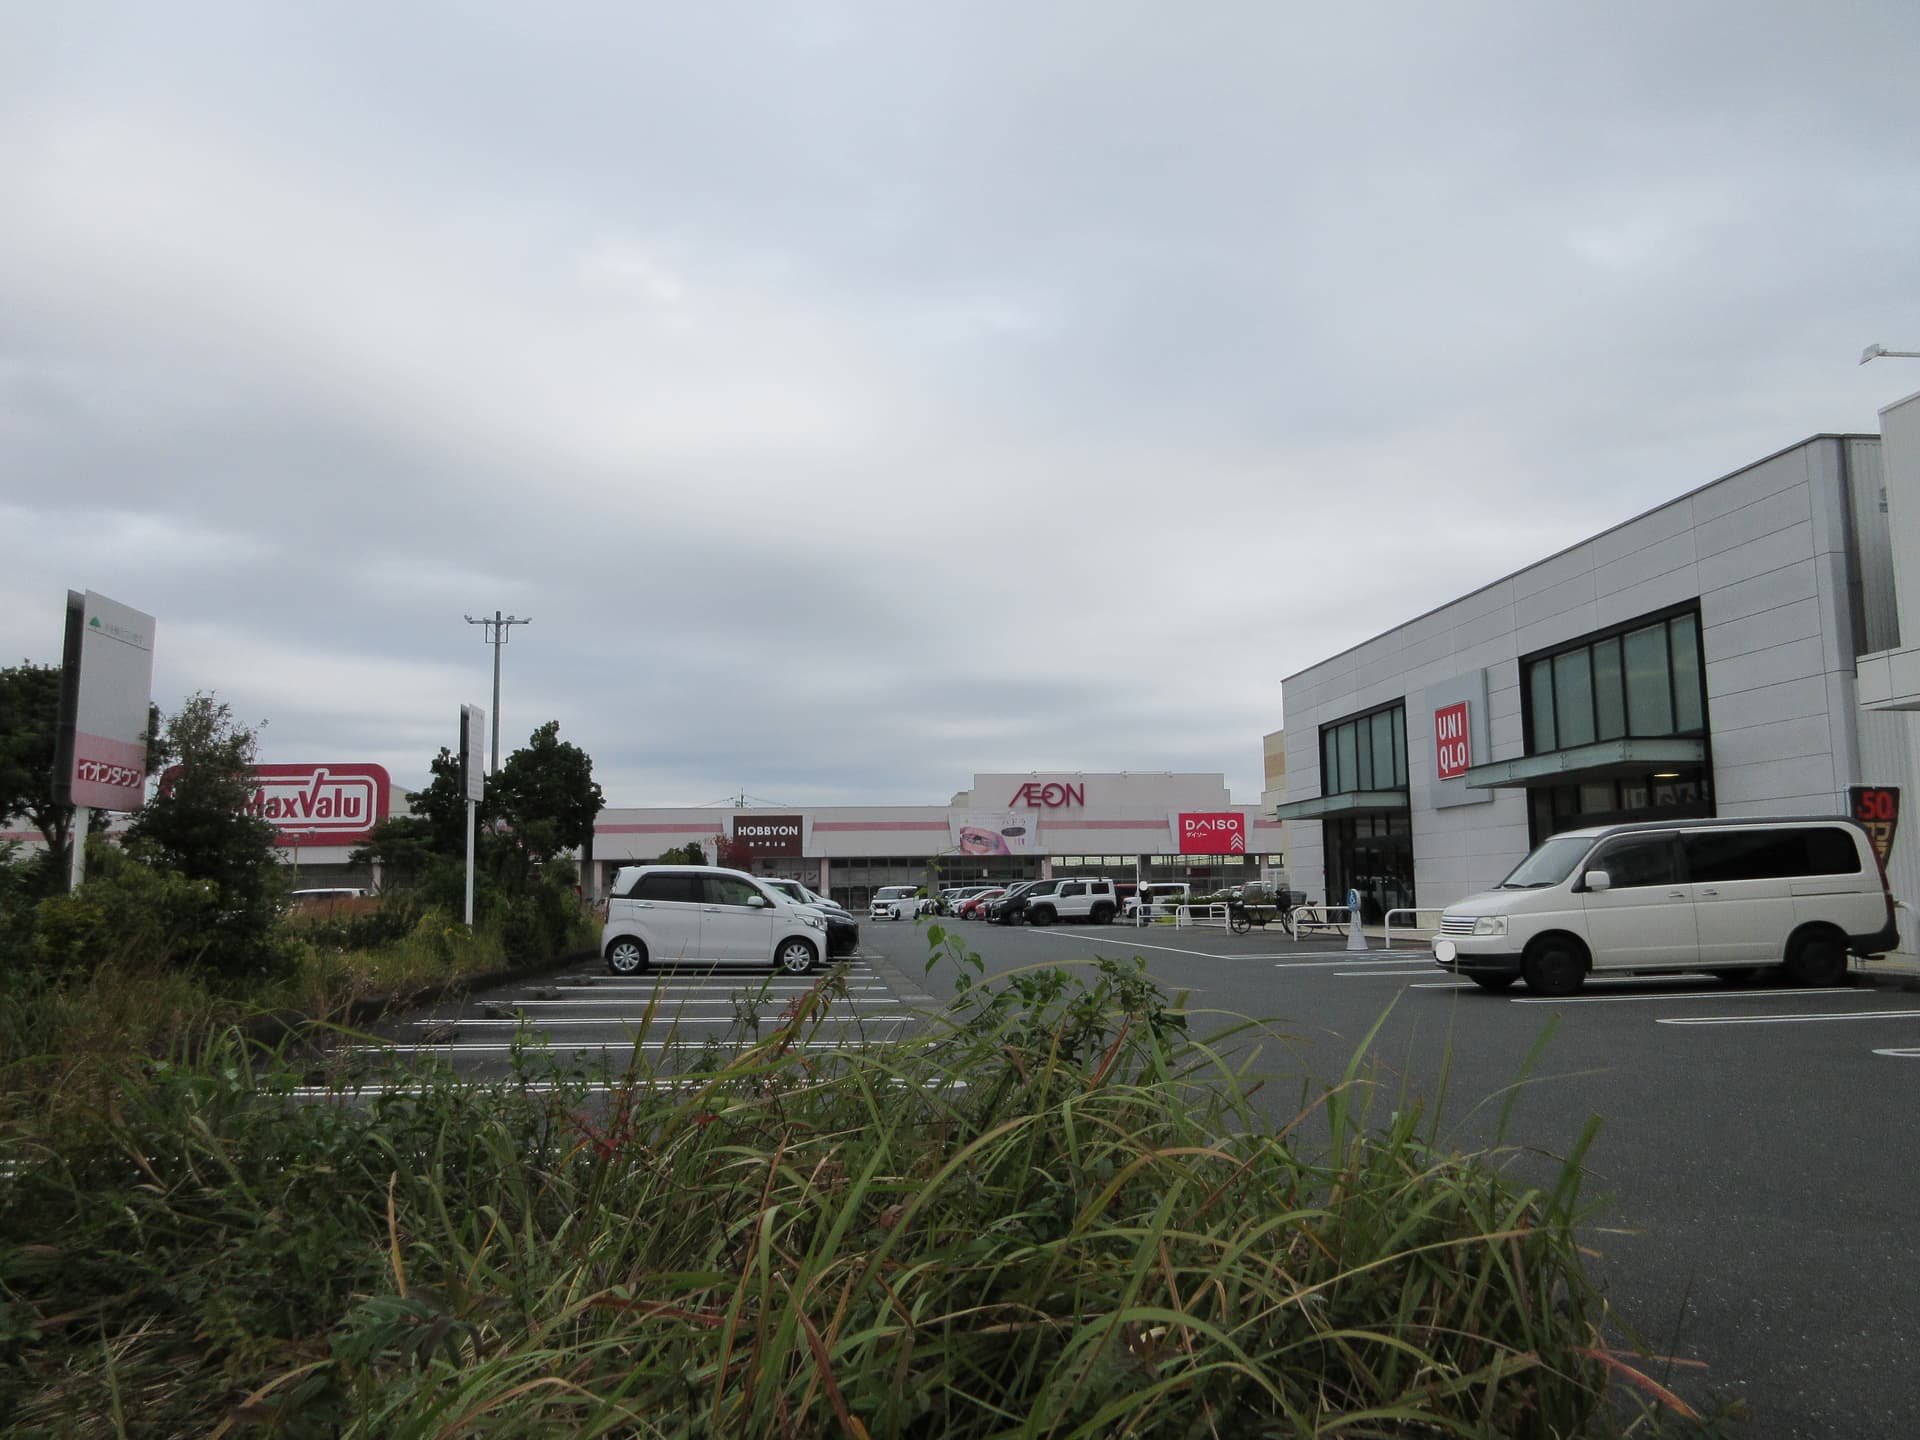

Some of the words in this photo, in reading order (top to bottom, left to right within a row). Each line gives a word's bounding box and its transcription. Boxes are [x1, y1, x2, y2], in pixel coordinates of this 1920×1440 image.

[1438, 712, 1462, 740] UNI
[1440, 742, 1466, 774] QLO
[80, 762, 141, 787] イオンタウン
[738, 826, 798, 836] HOBBYON
[1185, 819, 1238, 830] DAISO
